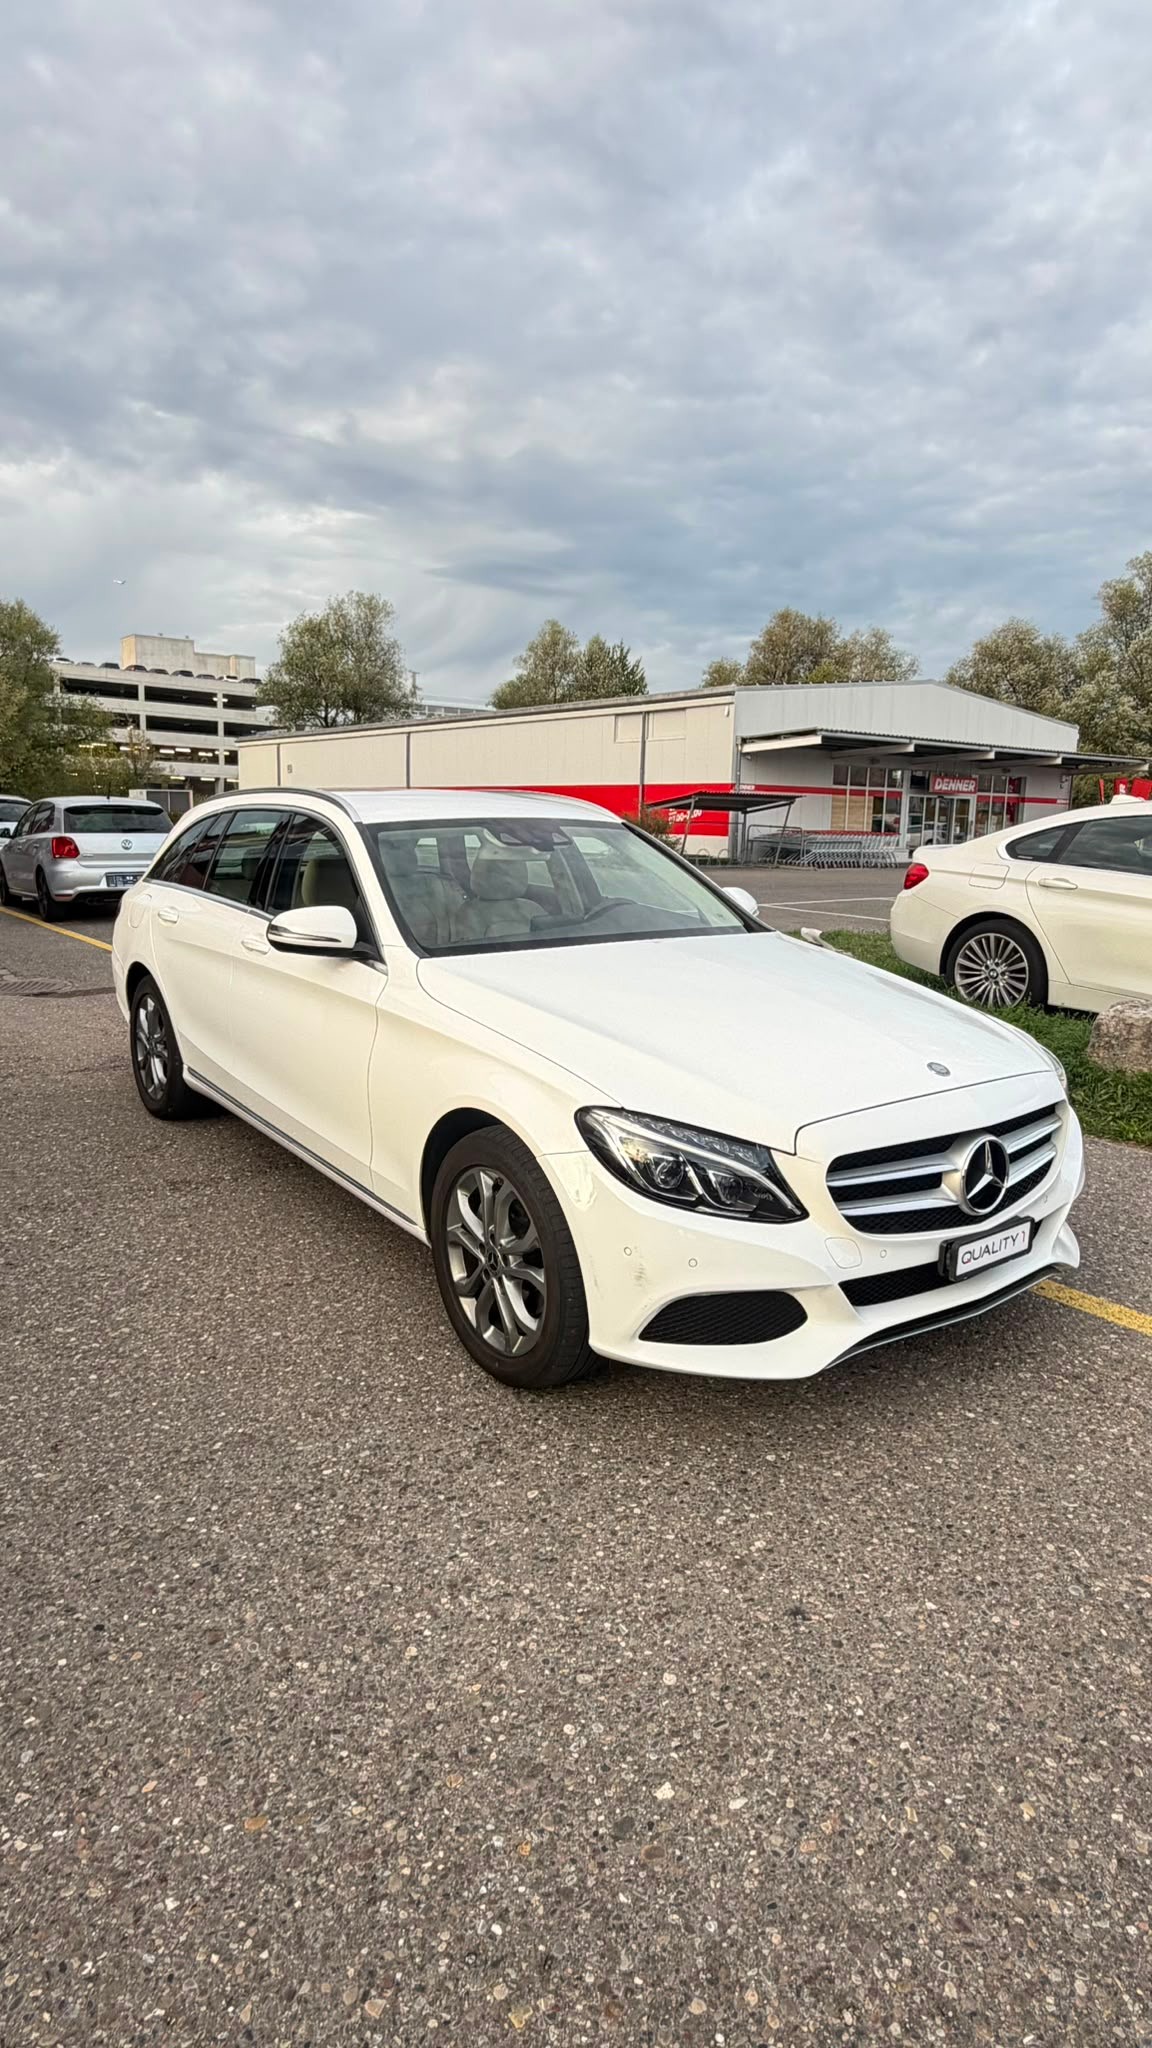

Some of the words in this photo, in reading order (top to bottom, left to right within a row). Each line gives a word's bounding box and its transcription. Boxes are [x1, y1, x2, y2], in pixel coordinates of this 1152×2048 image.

[934, 778, 976, 793] DENNER
[961, 1233, 1019, 1265] QUALITY
[1020, 1231, 1027, 1243] 1
